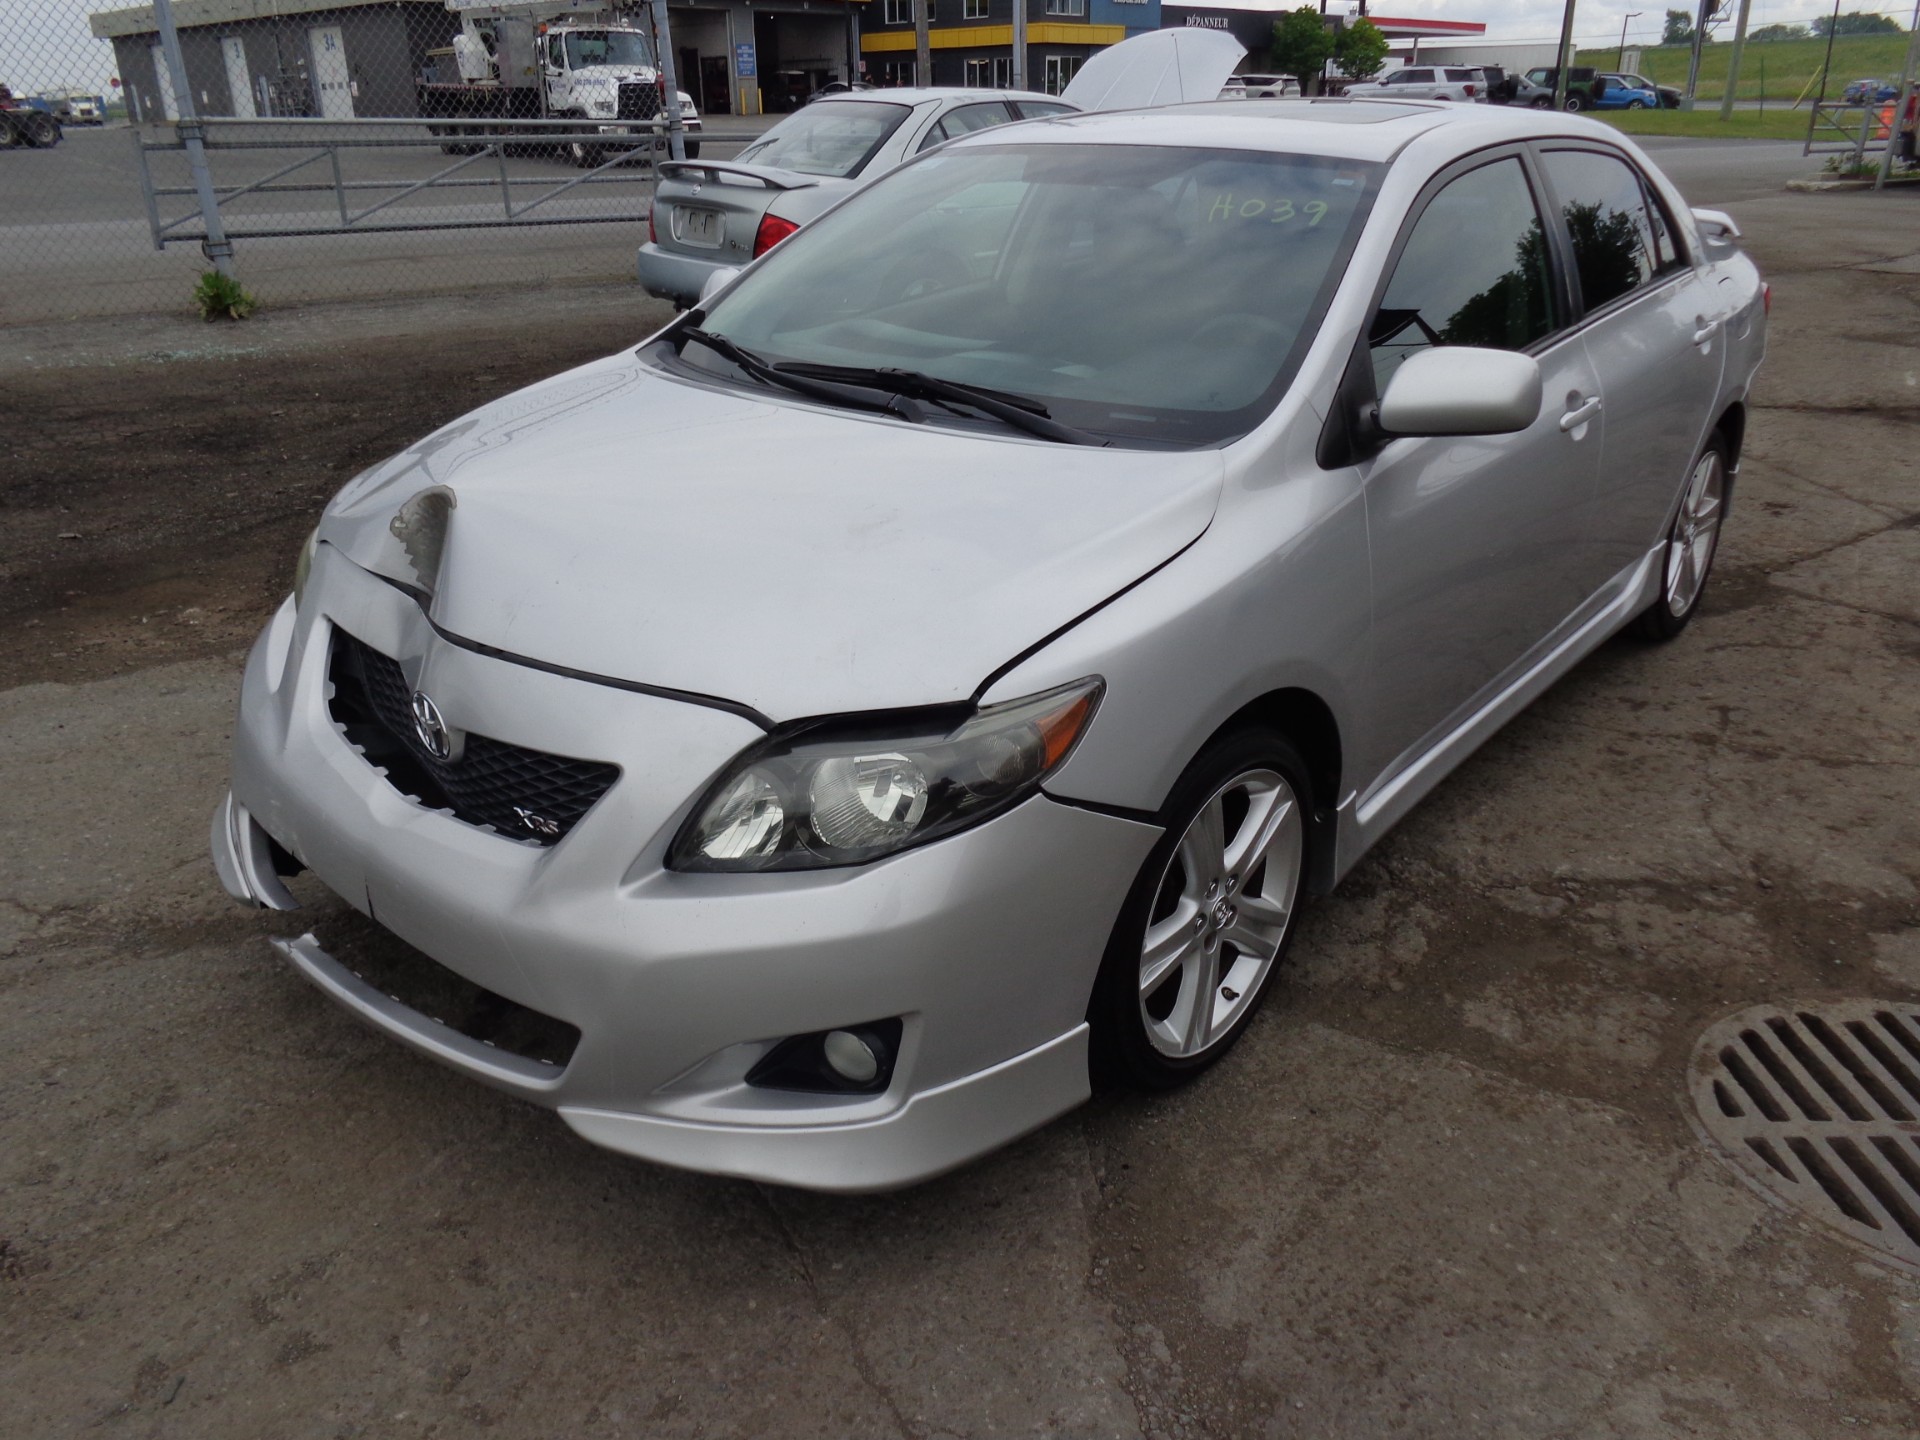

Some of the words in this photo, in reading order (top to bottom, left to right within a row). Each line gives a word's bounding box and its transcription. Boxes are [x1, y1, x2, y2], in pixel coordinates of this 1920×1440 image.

[1185, 14, 1228, 28] DÉPANNEUR
[322, 34, 336, 51] 3A
[1207, 193, 1328, 227] H039
[513, 806, 559, 834] XRS
